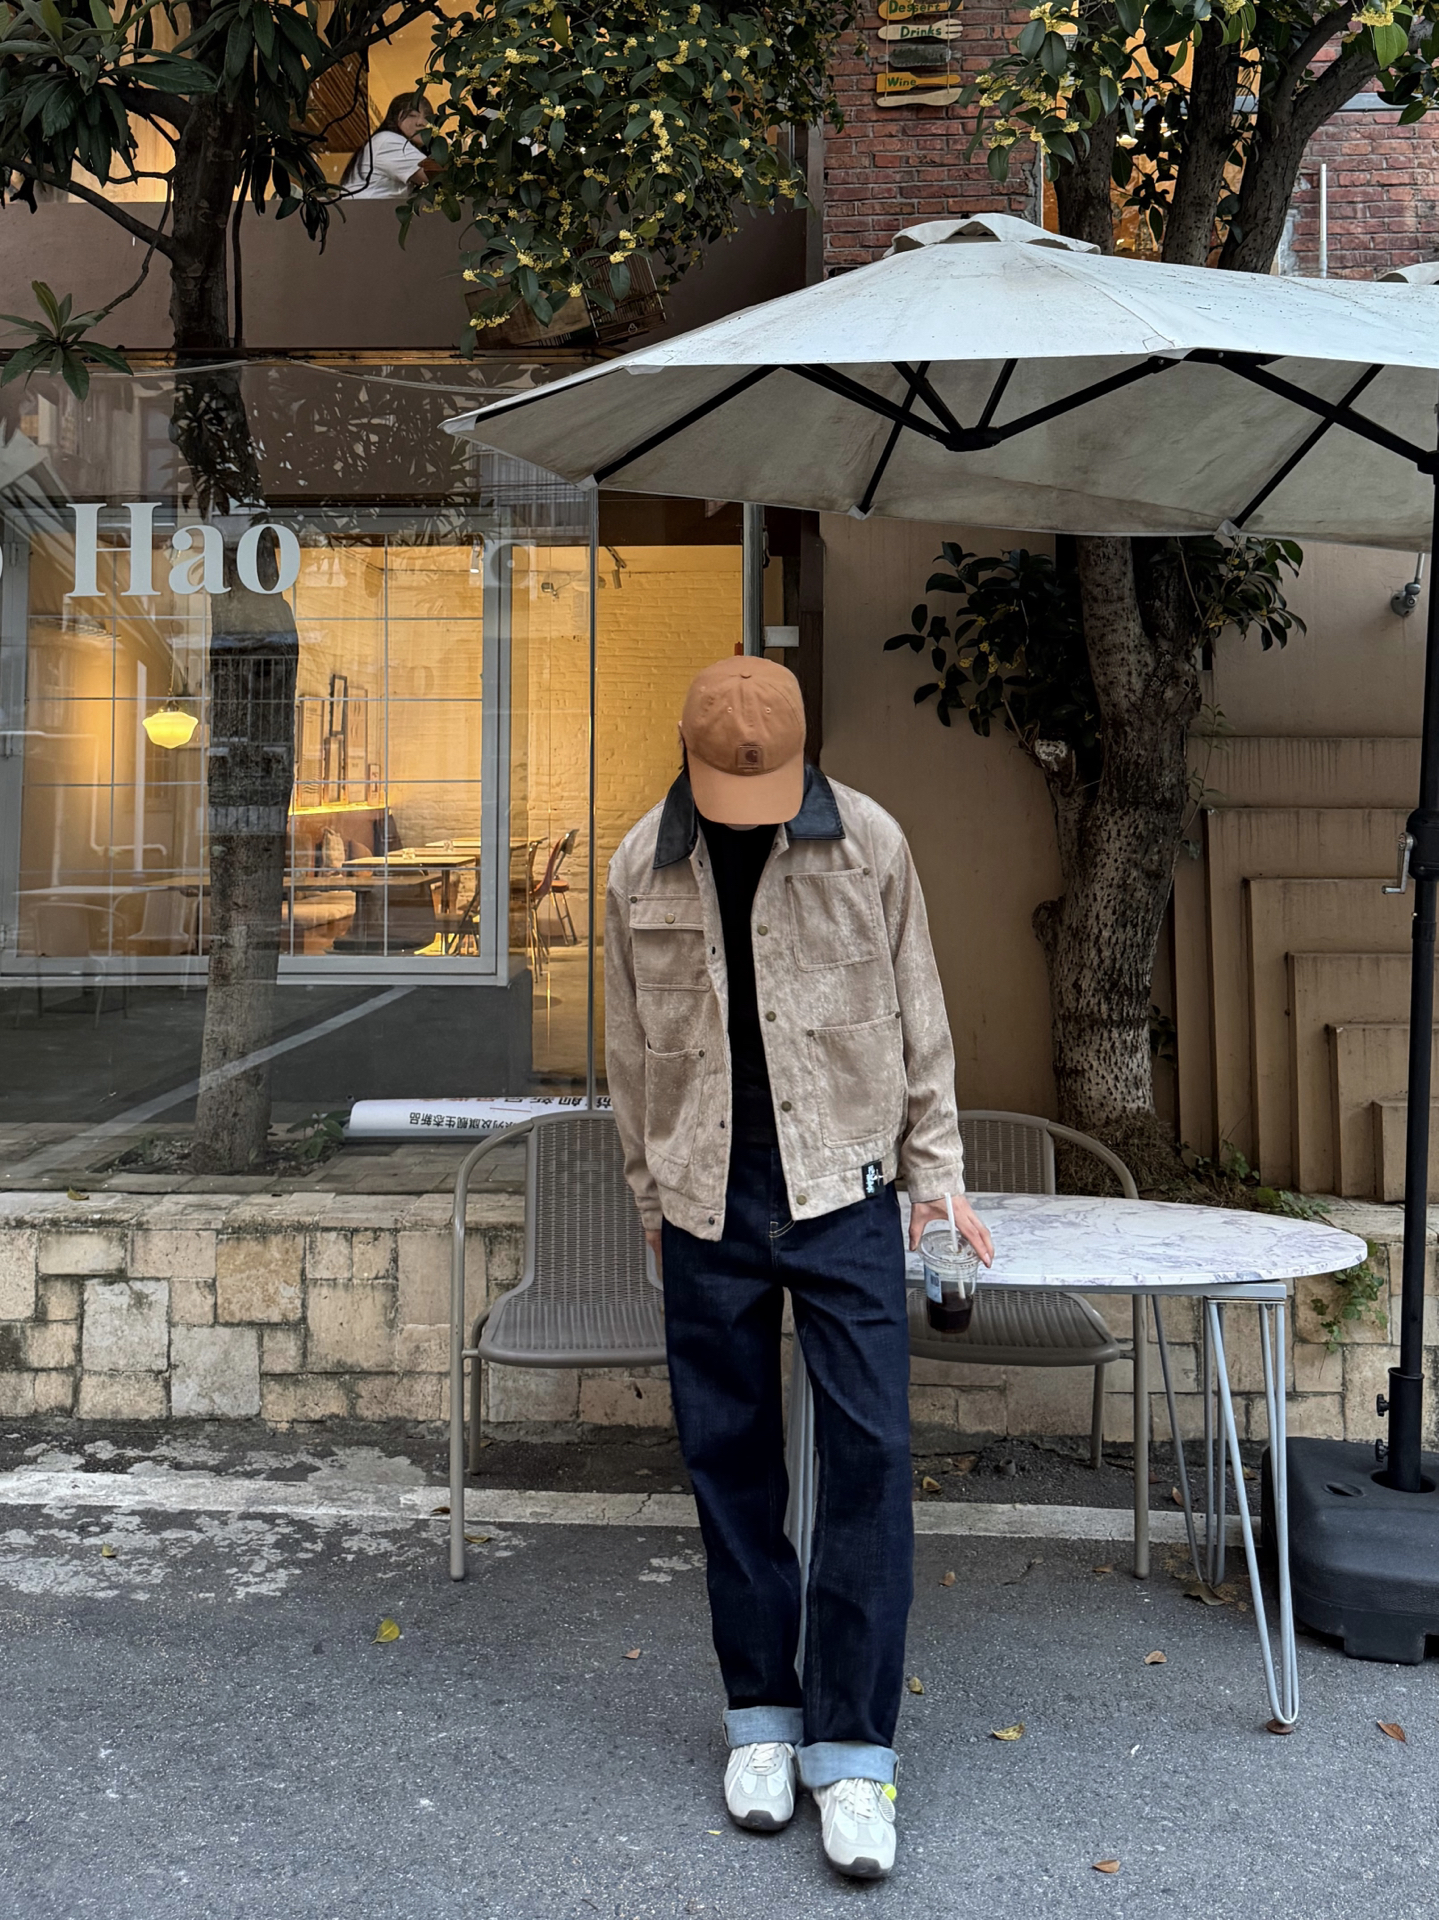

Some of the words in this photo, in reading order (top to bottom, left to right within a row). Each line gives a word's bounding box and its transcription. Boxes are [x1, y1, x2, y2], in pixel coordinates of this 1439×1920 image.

[889, 0, 941, 14] Dessert
[900, 25, 942, 38] Drinks
[887, 77, 917, 87] Wine
[66, 502, 300, 597] Hao
